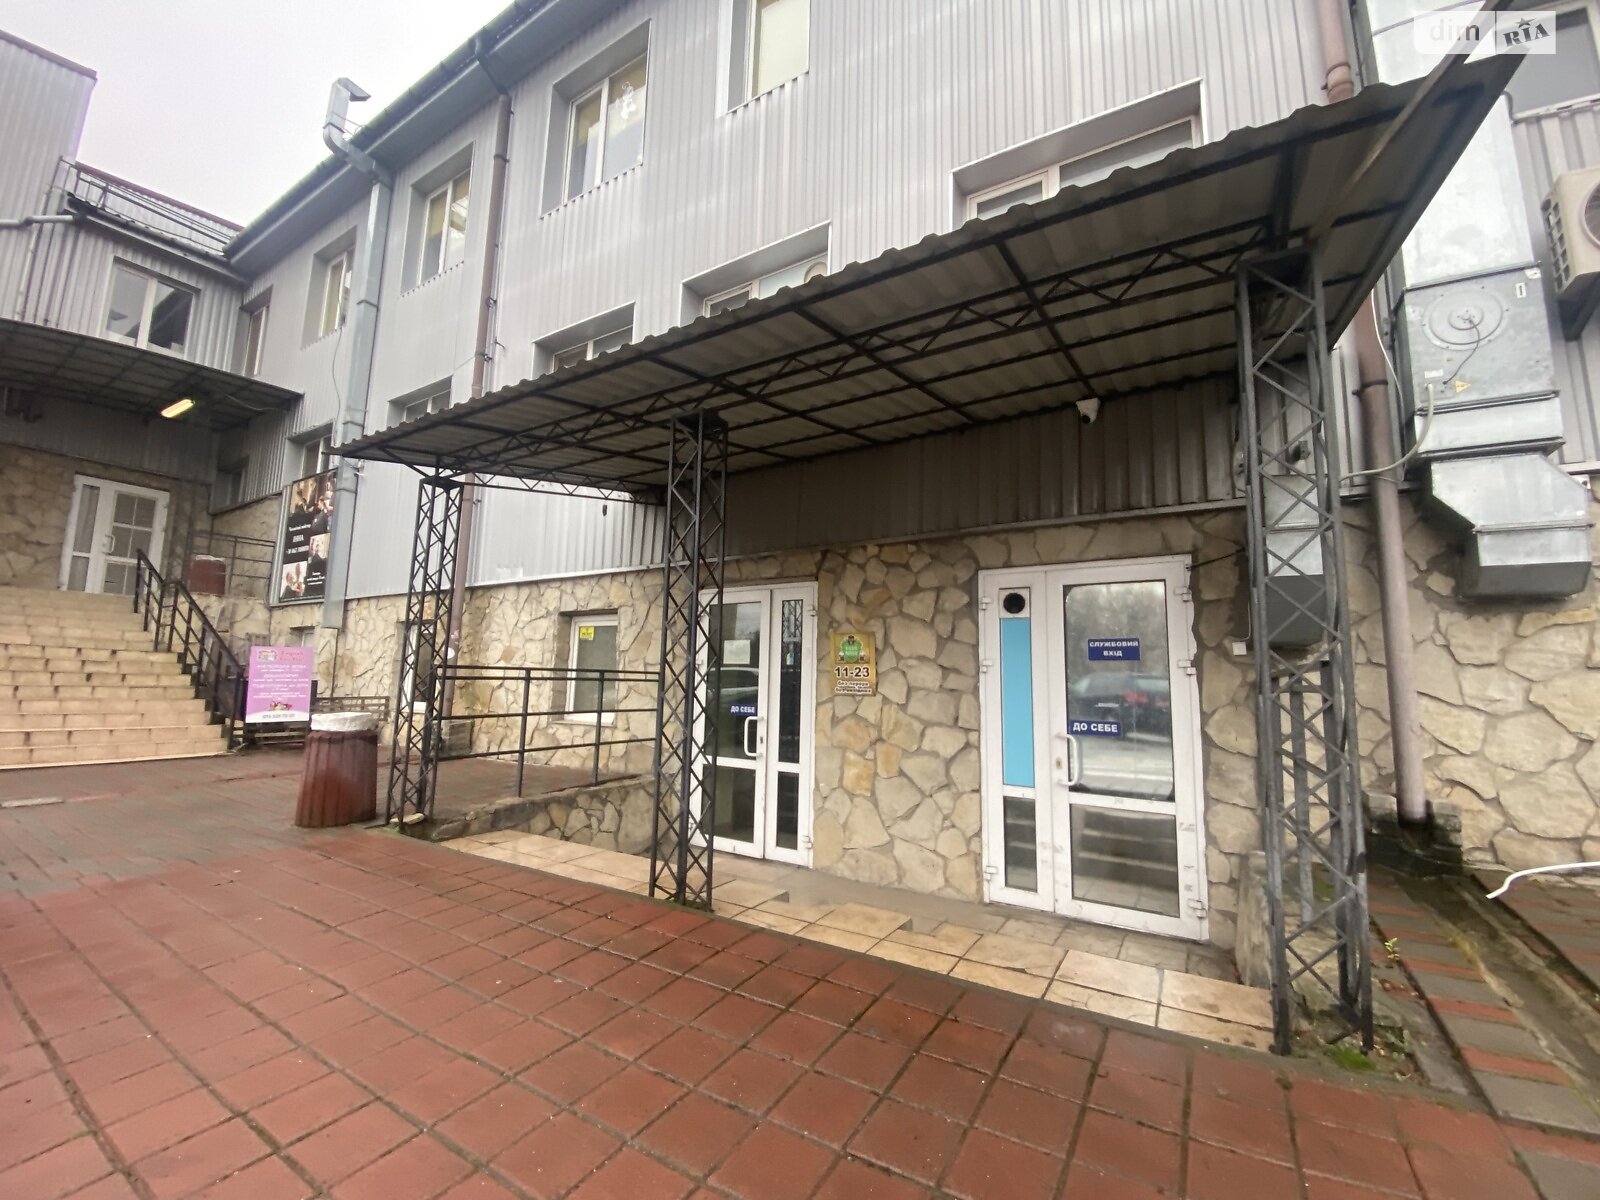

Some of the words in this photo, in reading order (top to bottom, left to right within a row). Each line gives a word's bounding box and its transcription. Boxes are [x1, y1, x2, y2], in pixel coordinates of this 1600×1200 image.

[835, 666, 870, 677] 11-23
[730, 705, 739, 713] ДО
[740, 705, 755, 713] СЕБЕ
[1072, 722, 1088, 731] ДО
[1090, 722, 1118, 733] СЕБЕ
